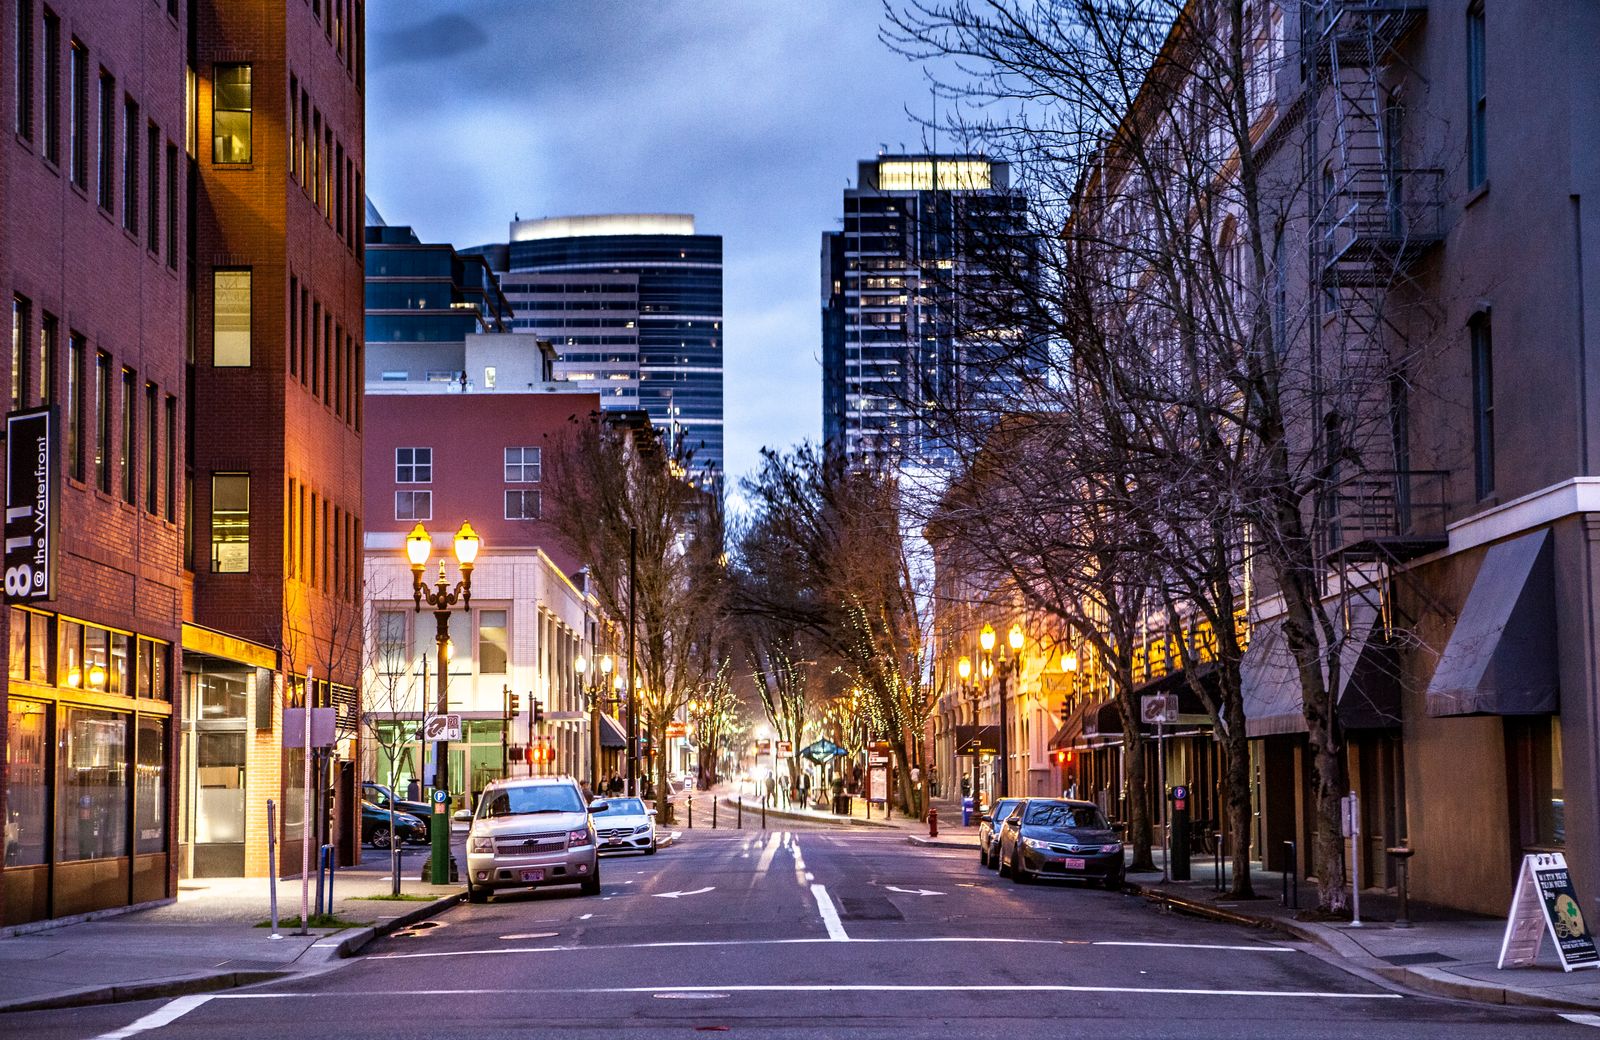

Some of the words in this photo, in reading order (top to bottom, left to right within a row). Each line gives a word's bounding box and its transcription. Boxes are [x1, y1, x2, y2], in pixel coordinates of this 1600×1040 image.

[34, 436, 46, 532] Waterfront
[5, 506, 32, 597] 811
[33, 537, 45, 564] the
